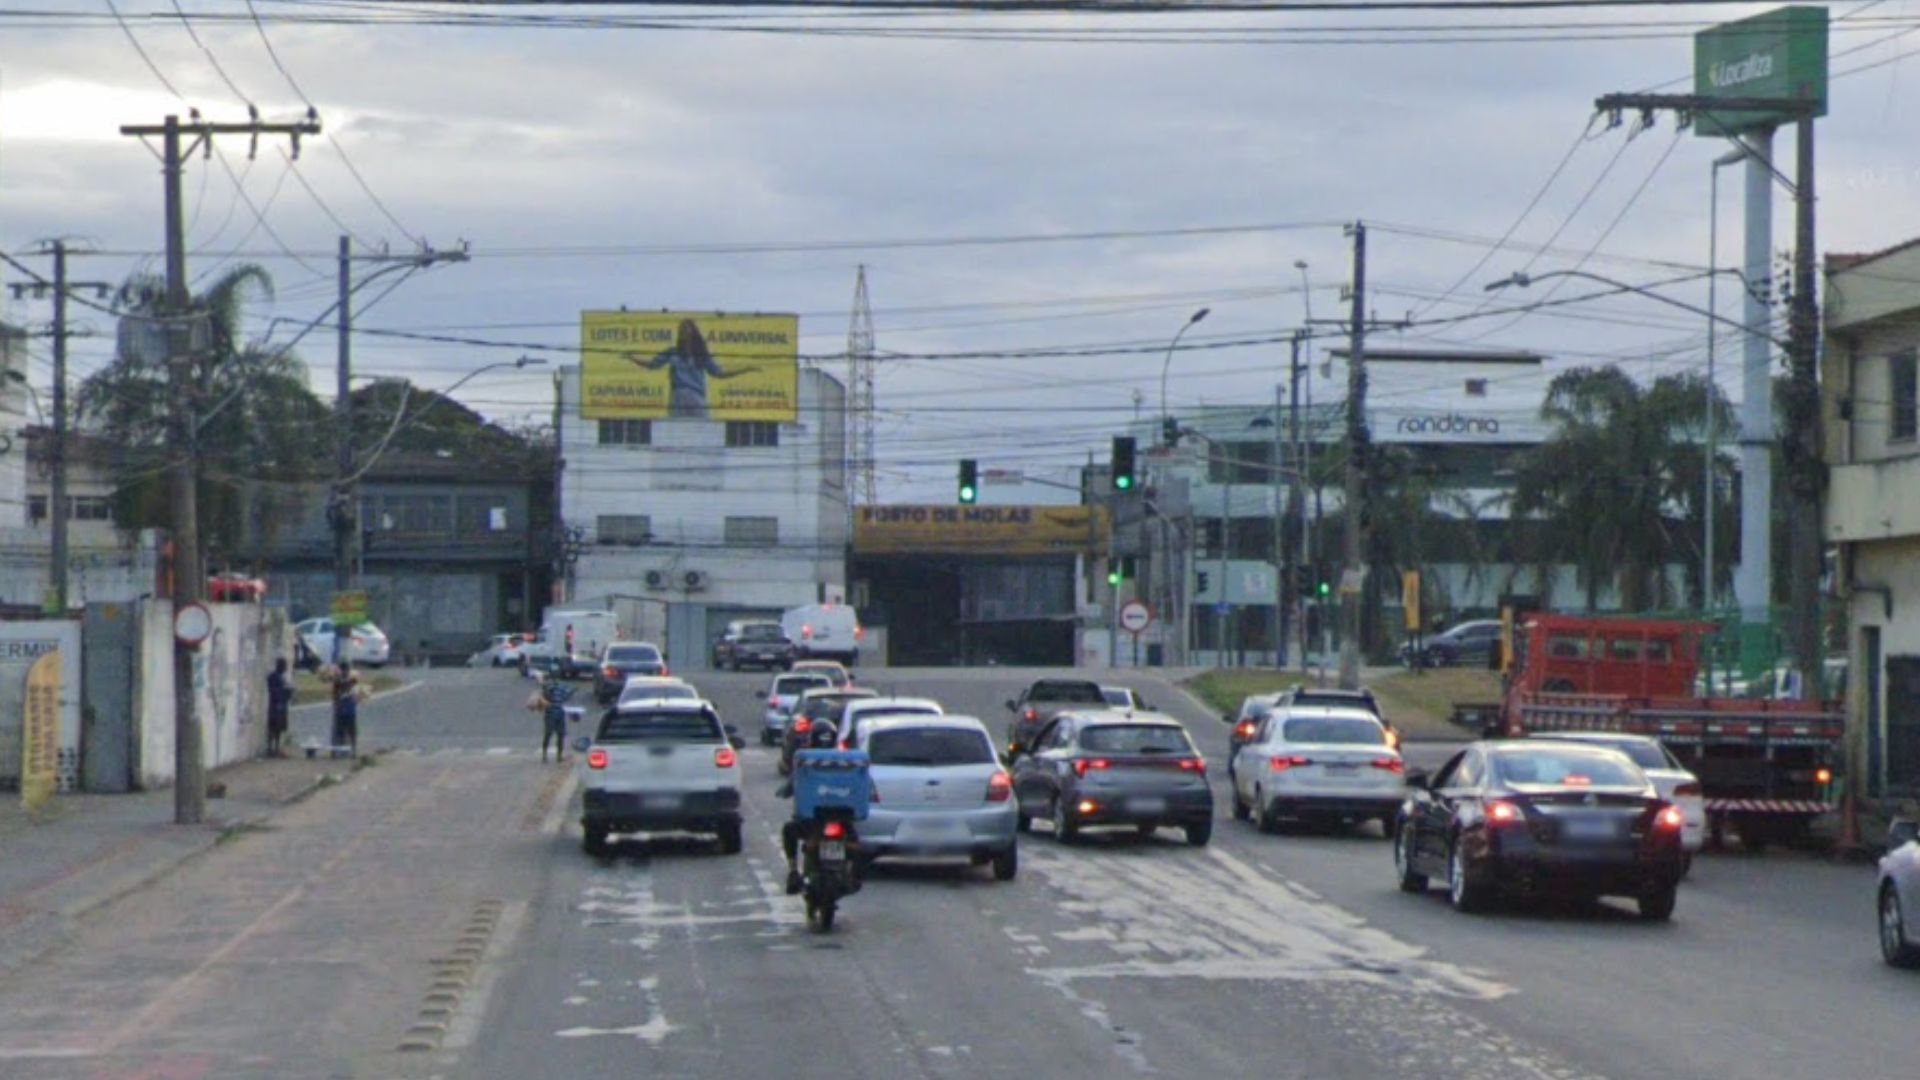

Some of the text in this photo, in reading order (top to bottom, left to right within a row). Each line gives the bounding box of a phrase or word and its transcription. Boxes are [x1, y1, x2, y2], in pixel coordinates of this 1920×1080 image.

[642, 328, 672, 342] COM
[719, 330, 789, 344] UNIVERSAL
[1397, 412, 1499, 434] rondônia
[932, 508, 958, 524] DE
[963, 508, 1033, 524] MOLAS
